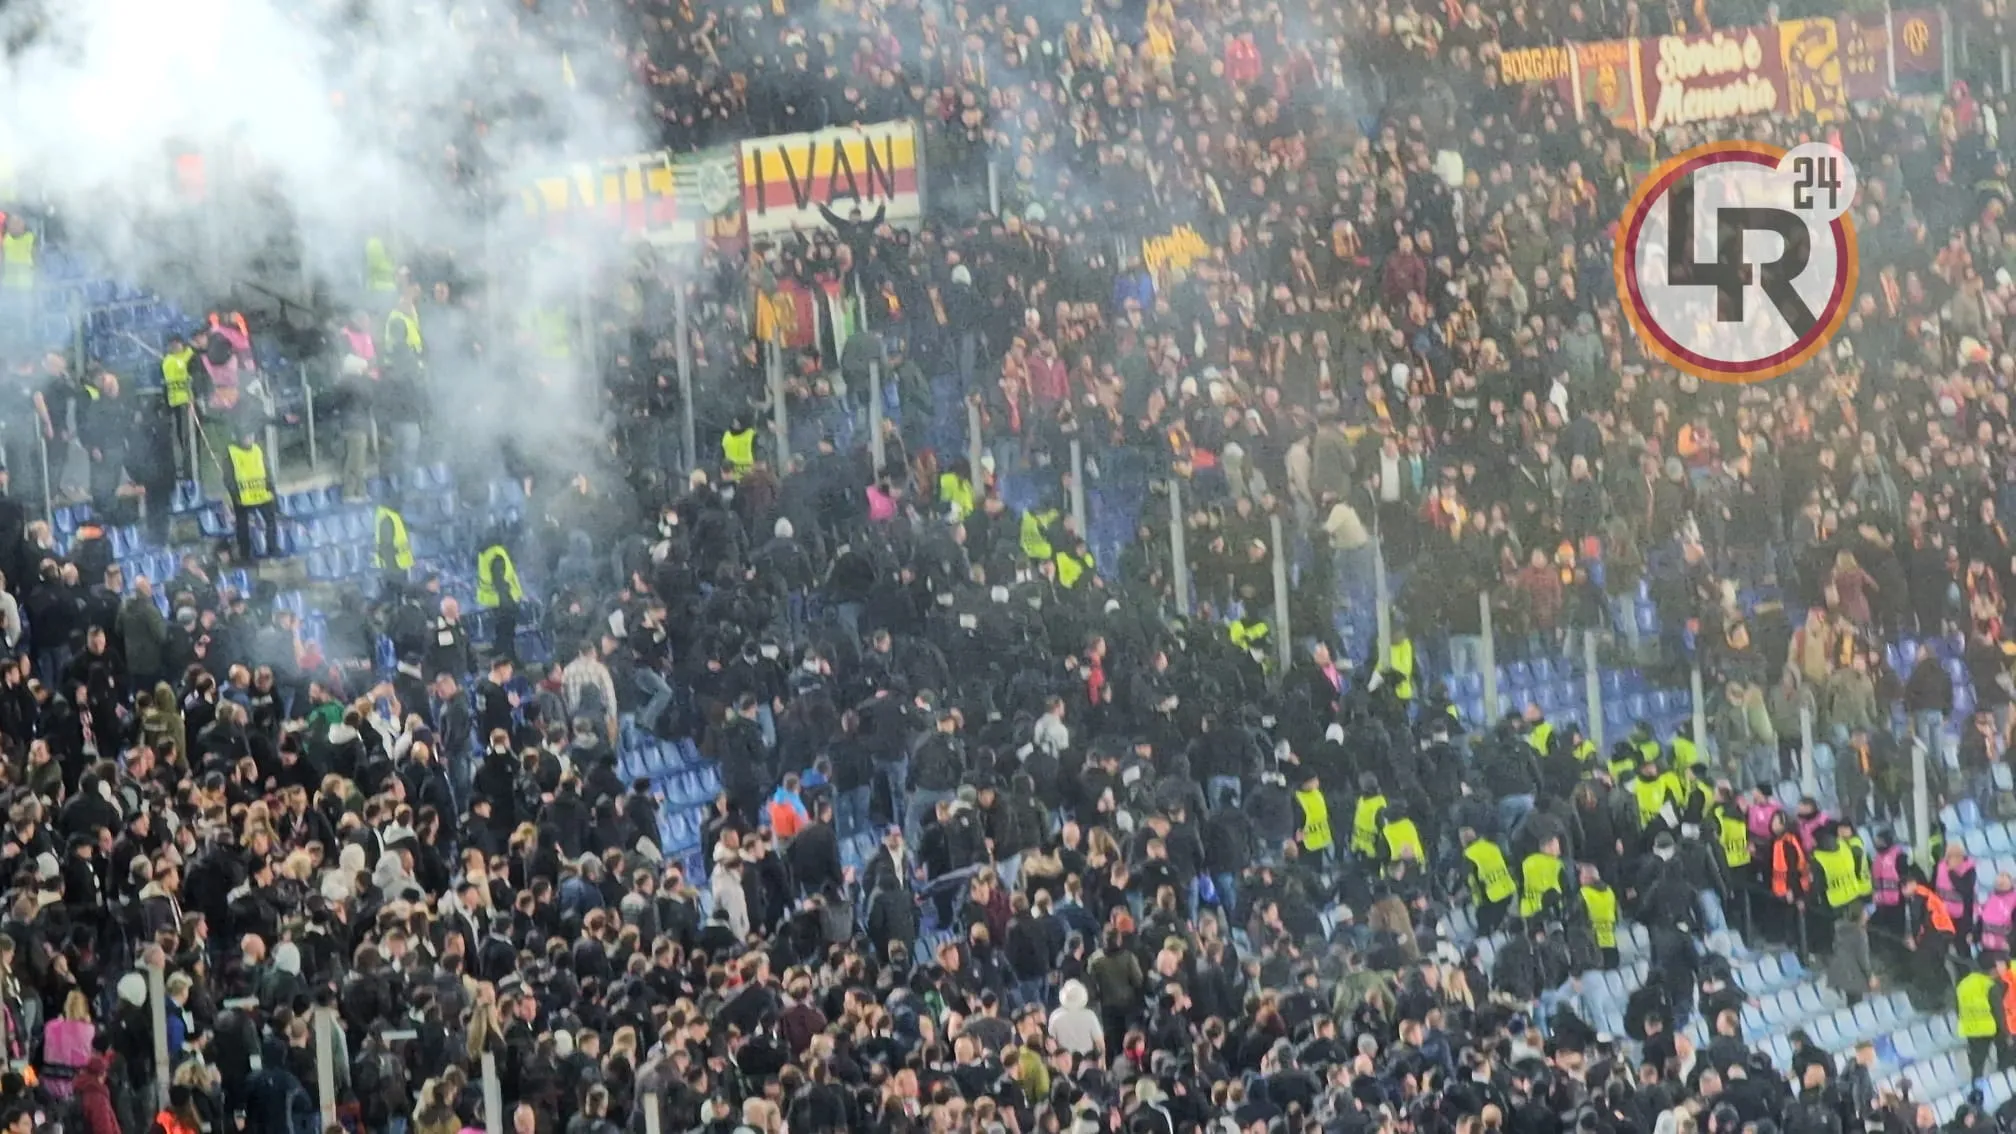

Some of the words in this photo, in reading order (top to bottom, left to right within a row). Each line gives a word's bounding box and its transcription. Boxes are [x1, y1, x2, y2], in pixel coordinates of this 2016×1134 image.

[1656, 33, 1743, 81] Storia
[1649, 72, 1777, 132] Memoria
[752, 133, 895, 216] IVAN
